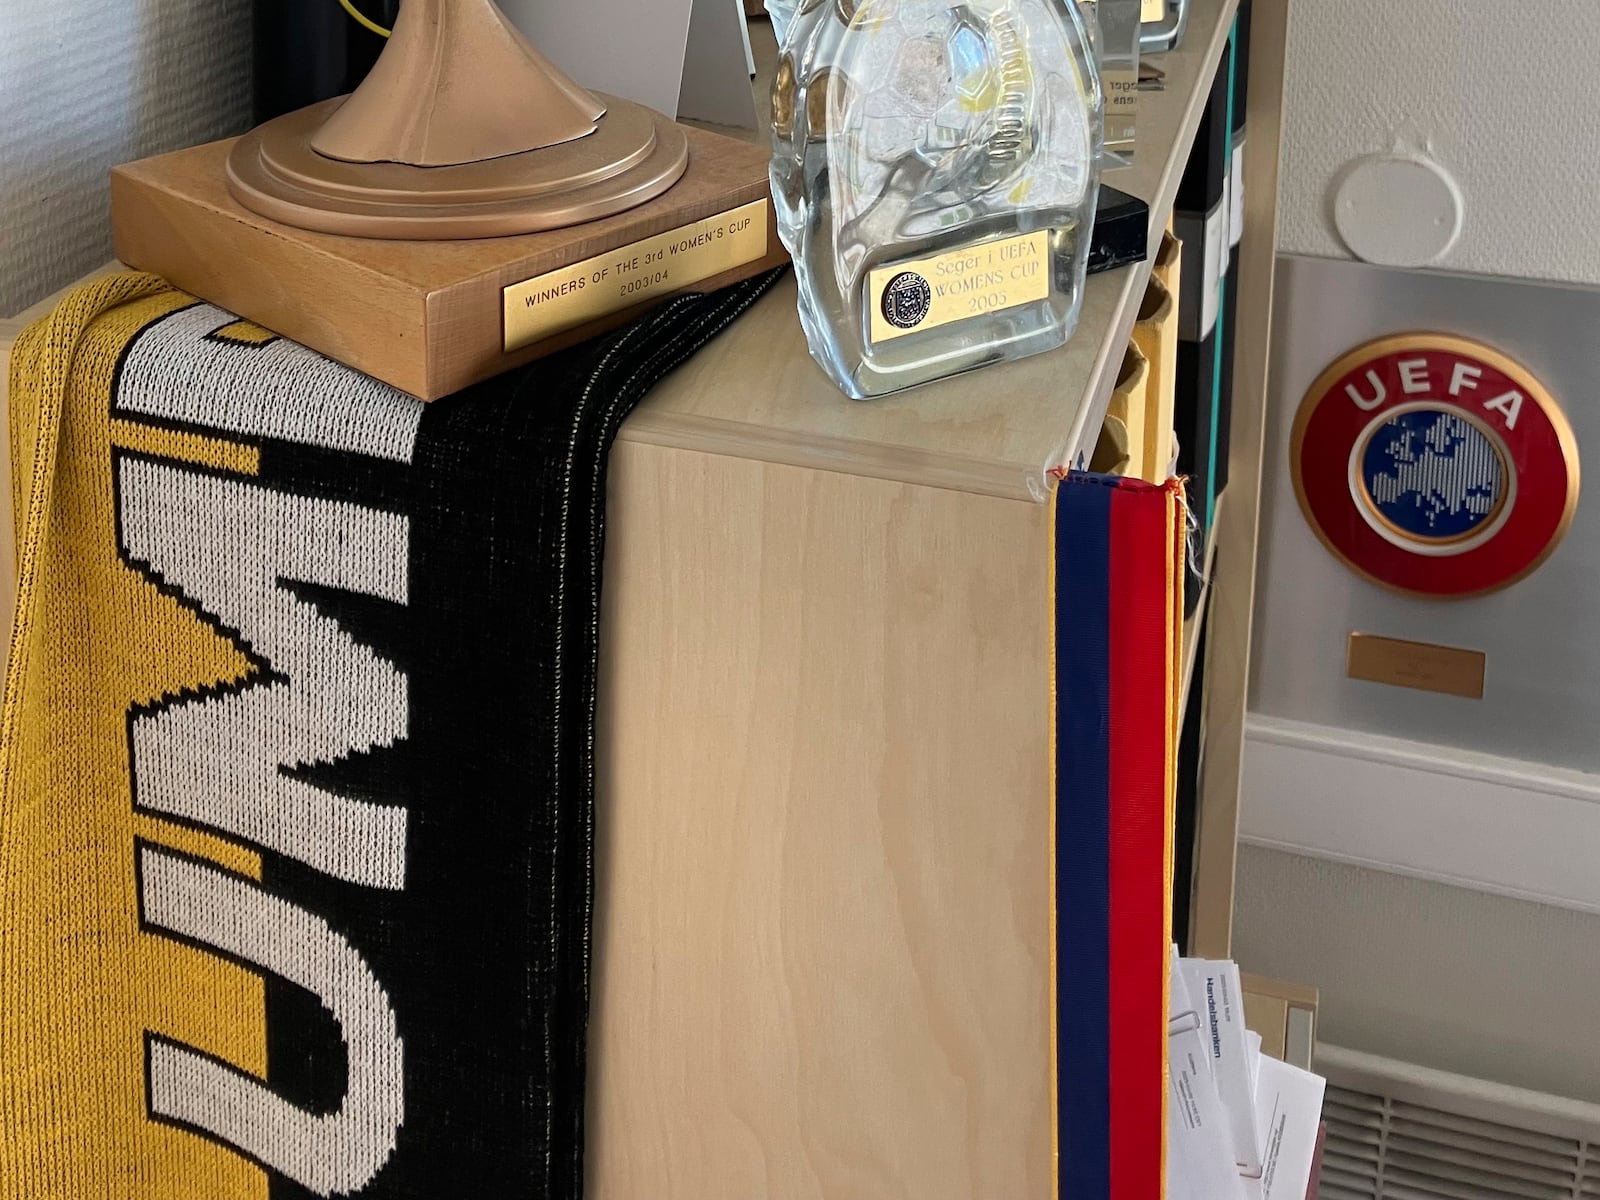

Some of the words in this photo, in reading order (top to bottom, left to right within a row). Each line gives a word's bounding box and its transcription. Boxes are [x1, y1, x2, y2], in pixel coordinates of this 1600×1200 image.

[525, 277, 586, 307] WINNERS
[592, 269, 609, 284] OF
[615, 257, 639, 276] THE
[644, 249, 664, 265] 3rd
[669, 227, 724, 256] WOMEN'S
[728, 217, 752, 235] CUP
[620, 269, 669, 297] 2003/04
[935, 270, 1004, 298] WOMENS
[1010, 261, 1040, 281] CUP
[936, 255, 980, 277] Seger
[1000, 240, 1037, 261] UEFA
[1344, 358, 1525, 431] UEFA
[1206, 977, 1221, 1058] Handelsbanken
